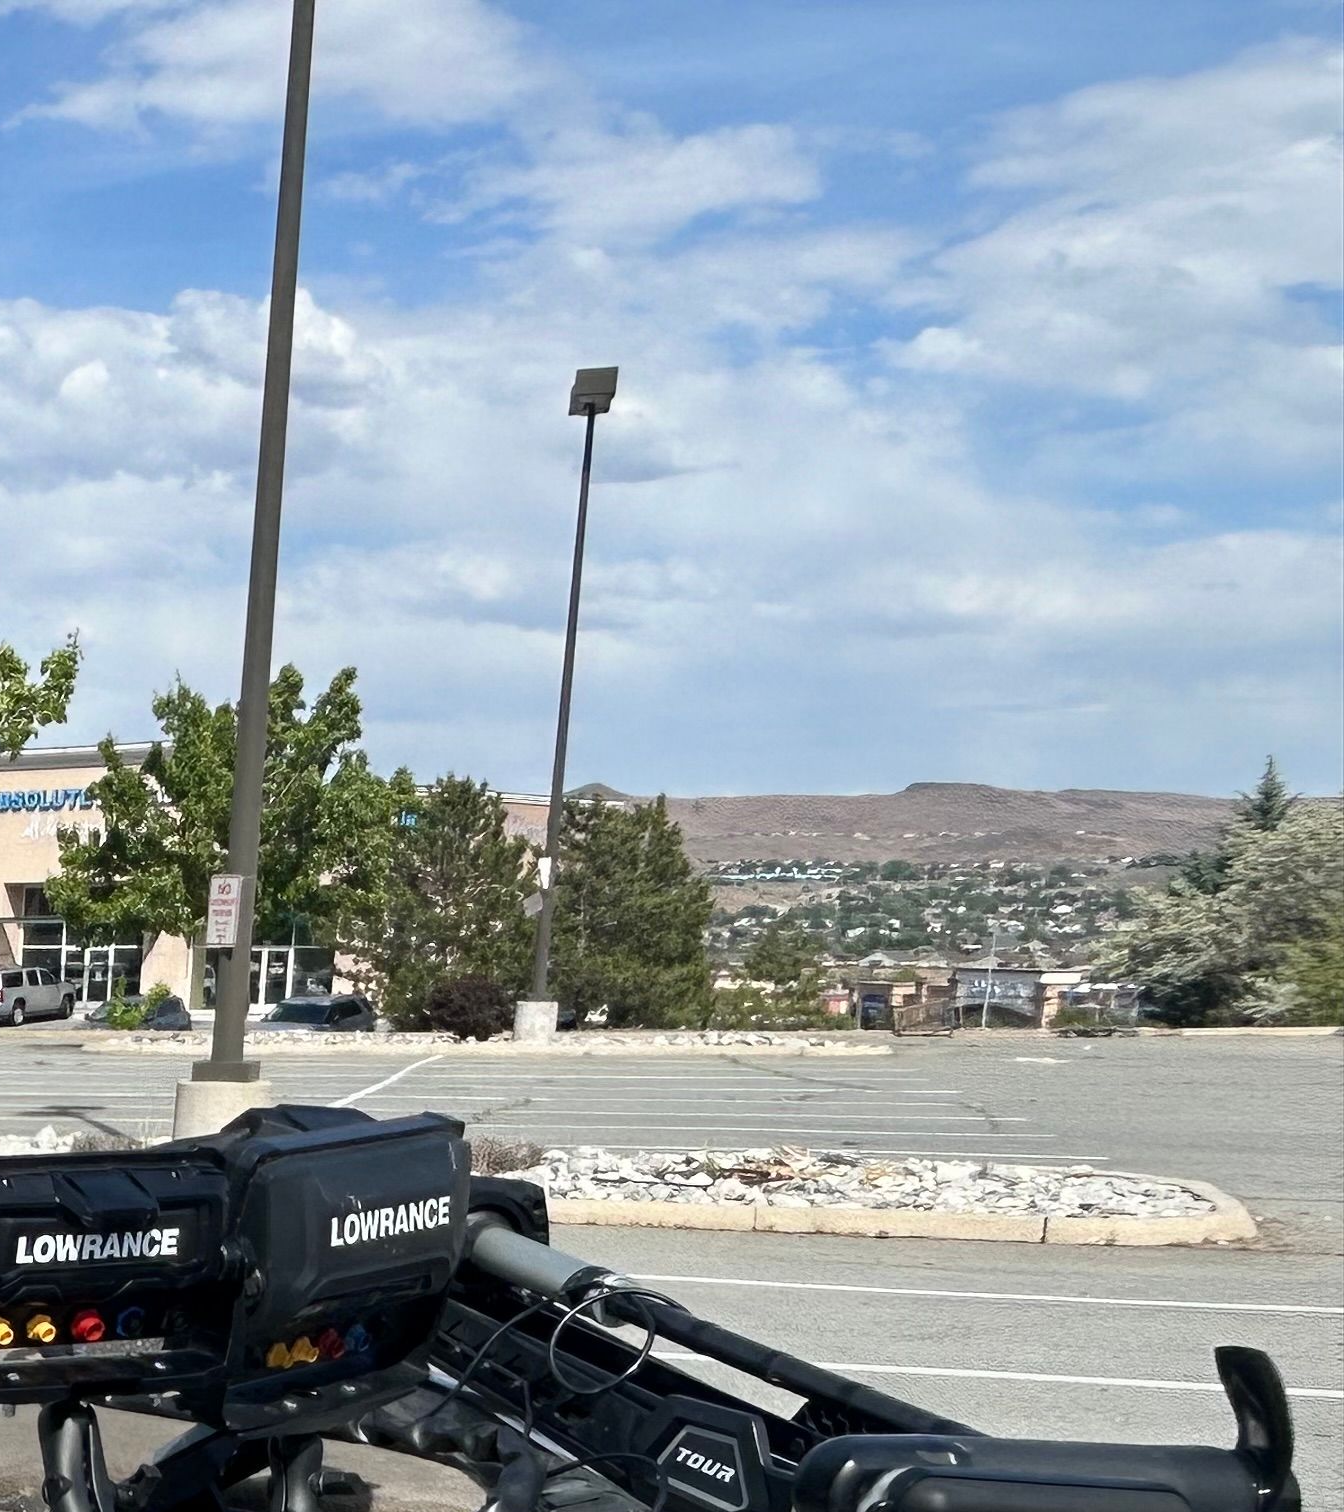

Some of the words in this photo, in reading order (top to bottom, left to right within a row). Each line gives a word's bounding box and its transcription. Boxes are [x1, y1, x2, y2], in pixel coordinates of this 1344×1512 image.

[330, 1195, 452, 1248] LOWRANCE
[15, 1228, 181, 1265] LOWRANCE
[675, 1446, 736, 1483] TOUR
